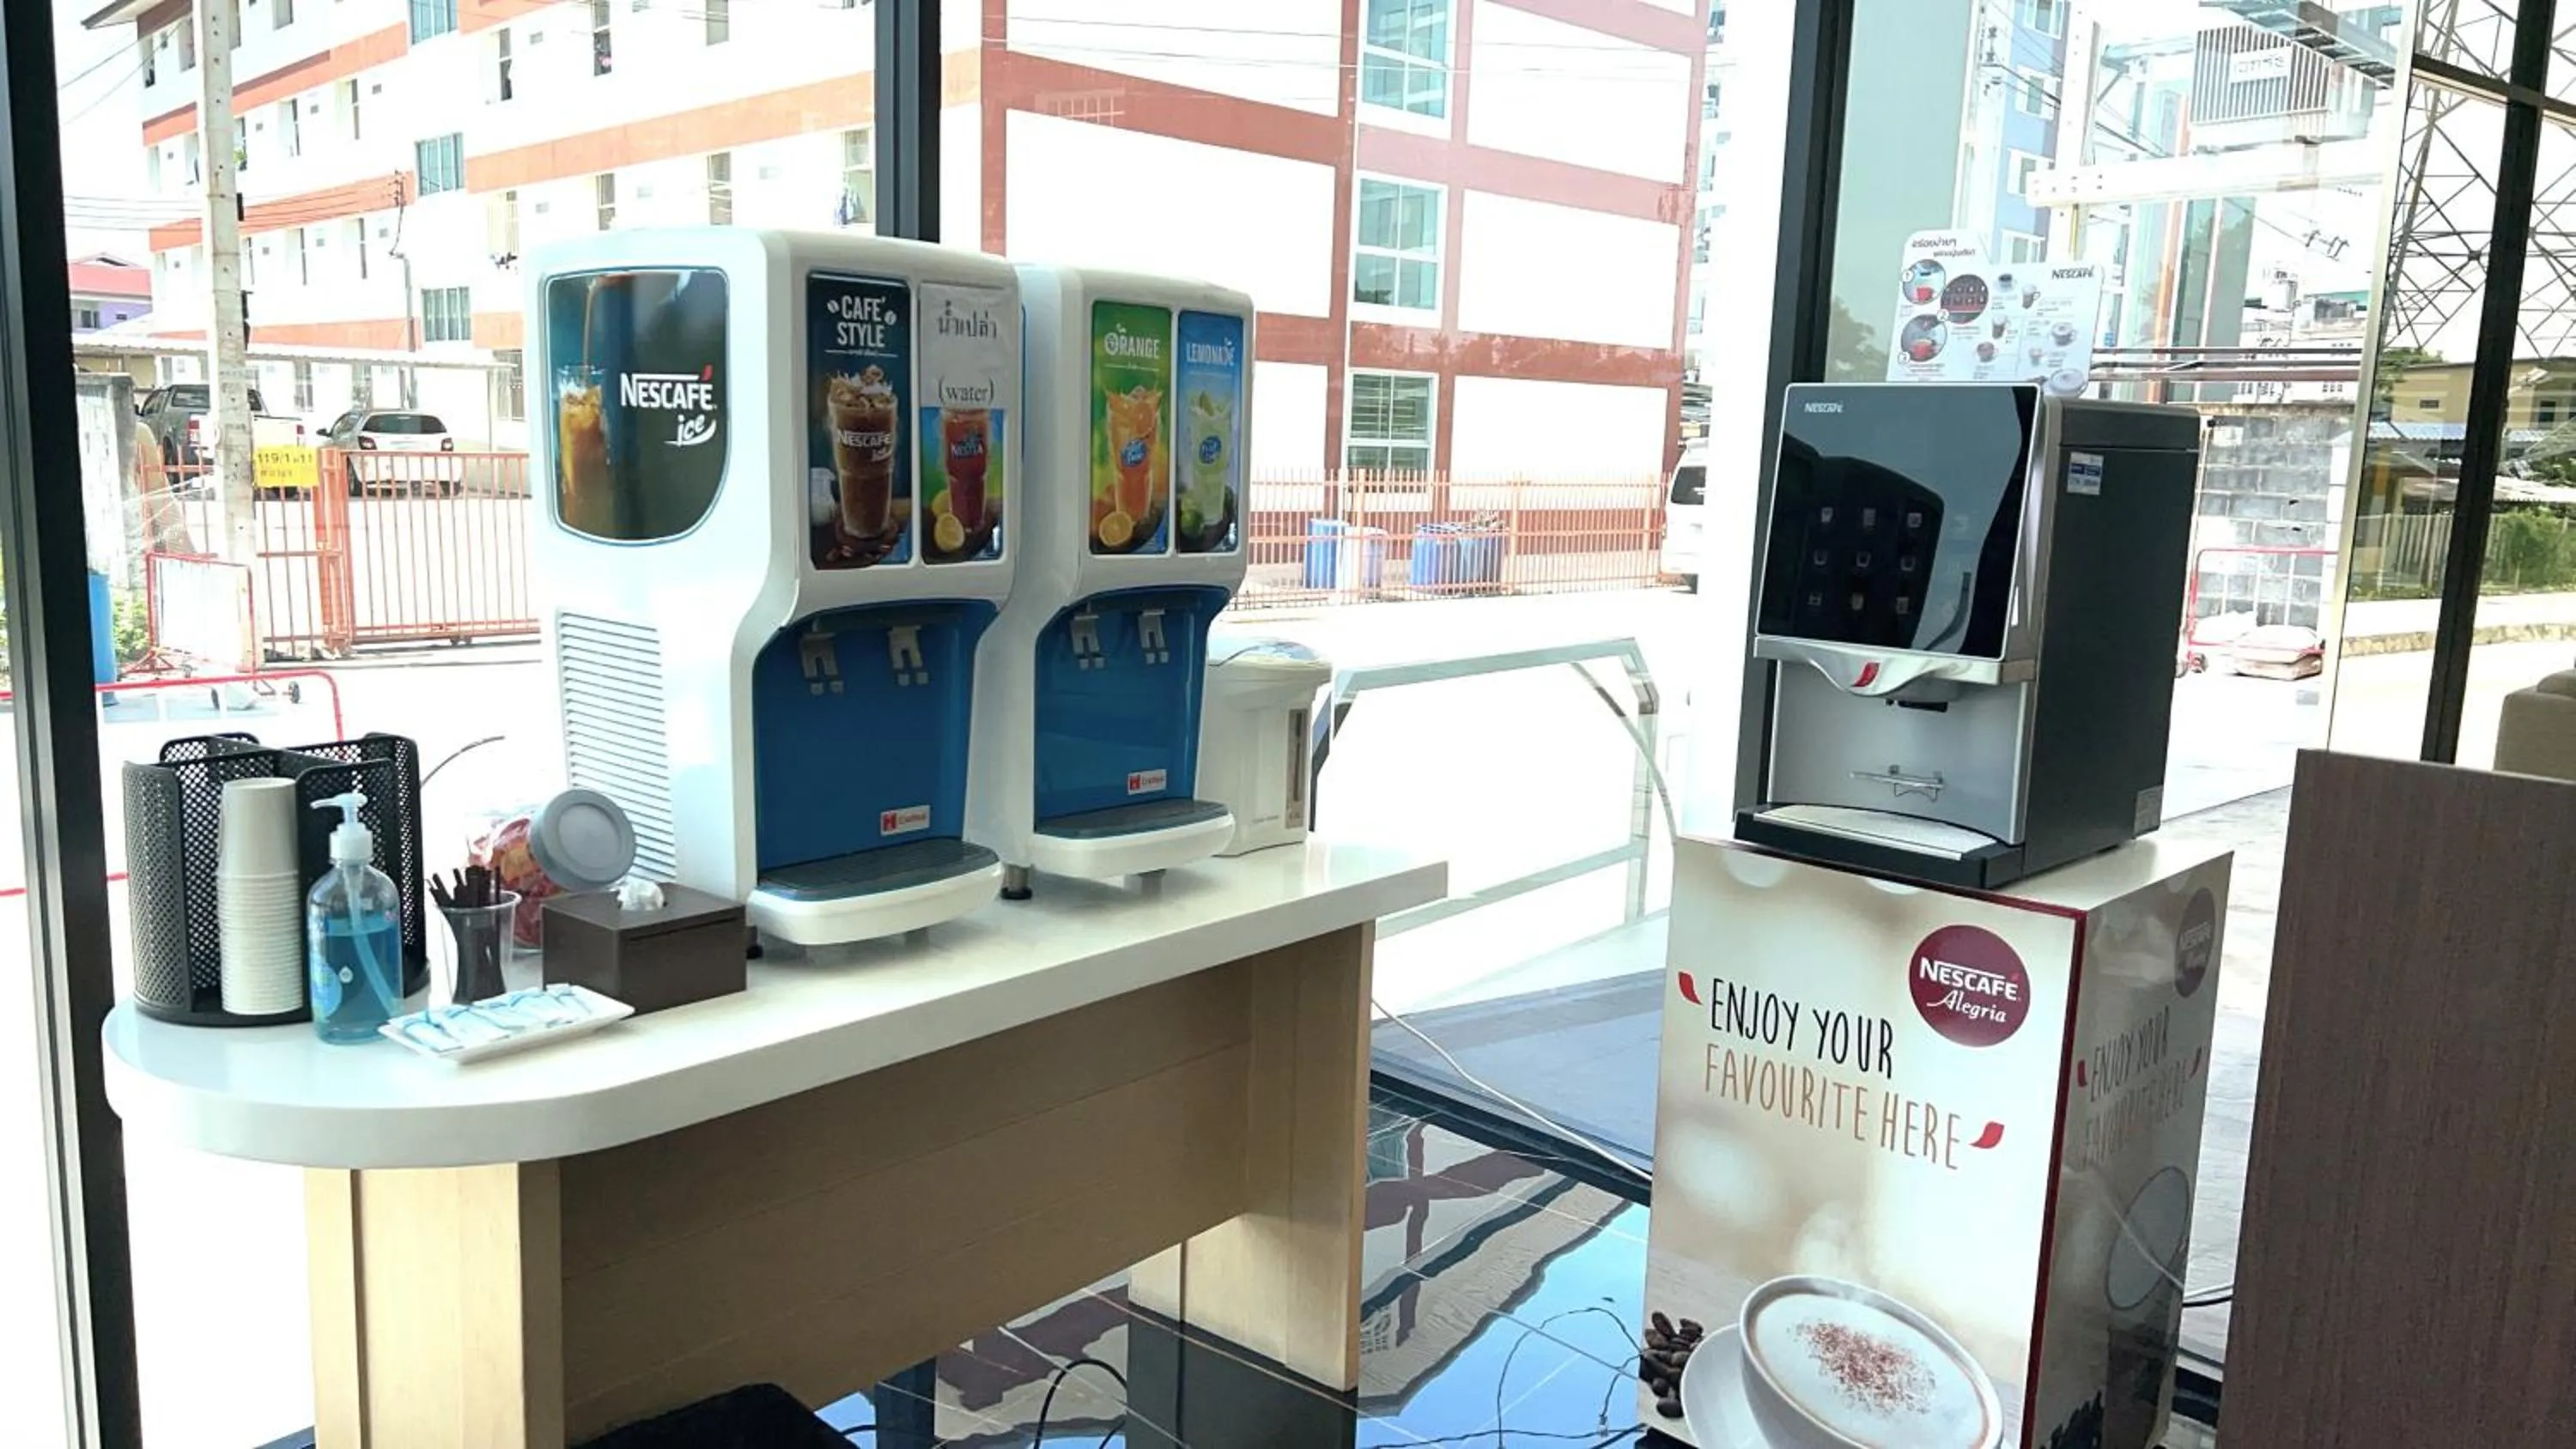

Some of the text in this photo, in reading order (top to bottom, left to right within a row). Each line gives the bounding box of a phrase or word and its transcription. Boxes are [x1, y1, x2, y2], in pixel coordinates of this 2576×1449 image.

[836, 322, 886, 348] STYLE
[937, 300, 998, 339] น้ำเปล่า
[1104, 331, 1161, 360] ORANGE
[1186, 343, 1235, 366] LEMONADE
[938, 378, 994, 404] (water)
[670, 414, 714, 446] ice
[1927, 990, 2008, 1023] Alegria
[1710, 978, 1895, 1080] ENJOY YOUR
[1704, 1043, 1962, 1171] FAVOURITE HERE
